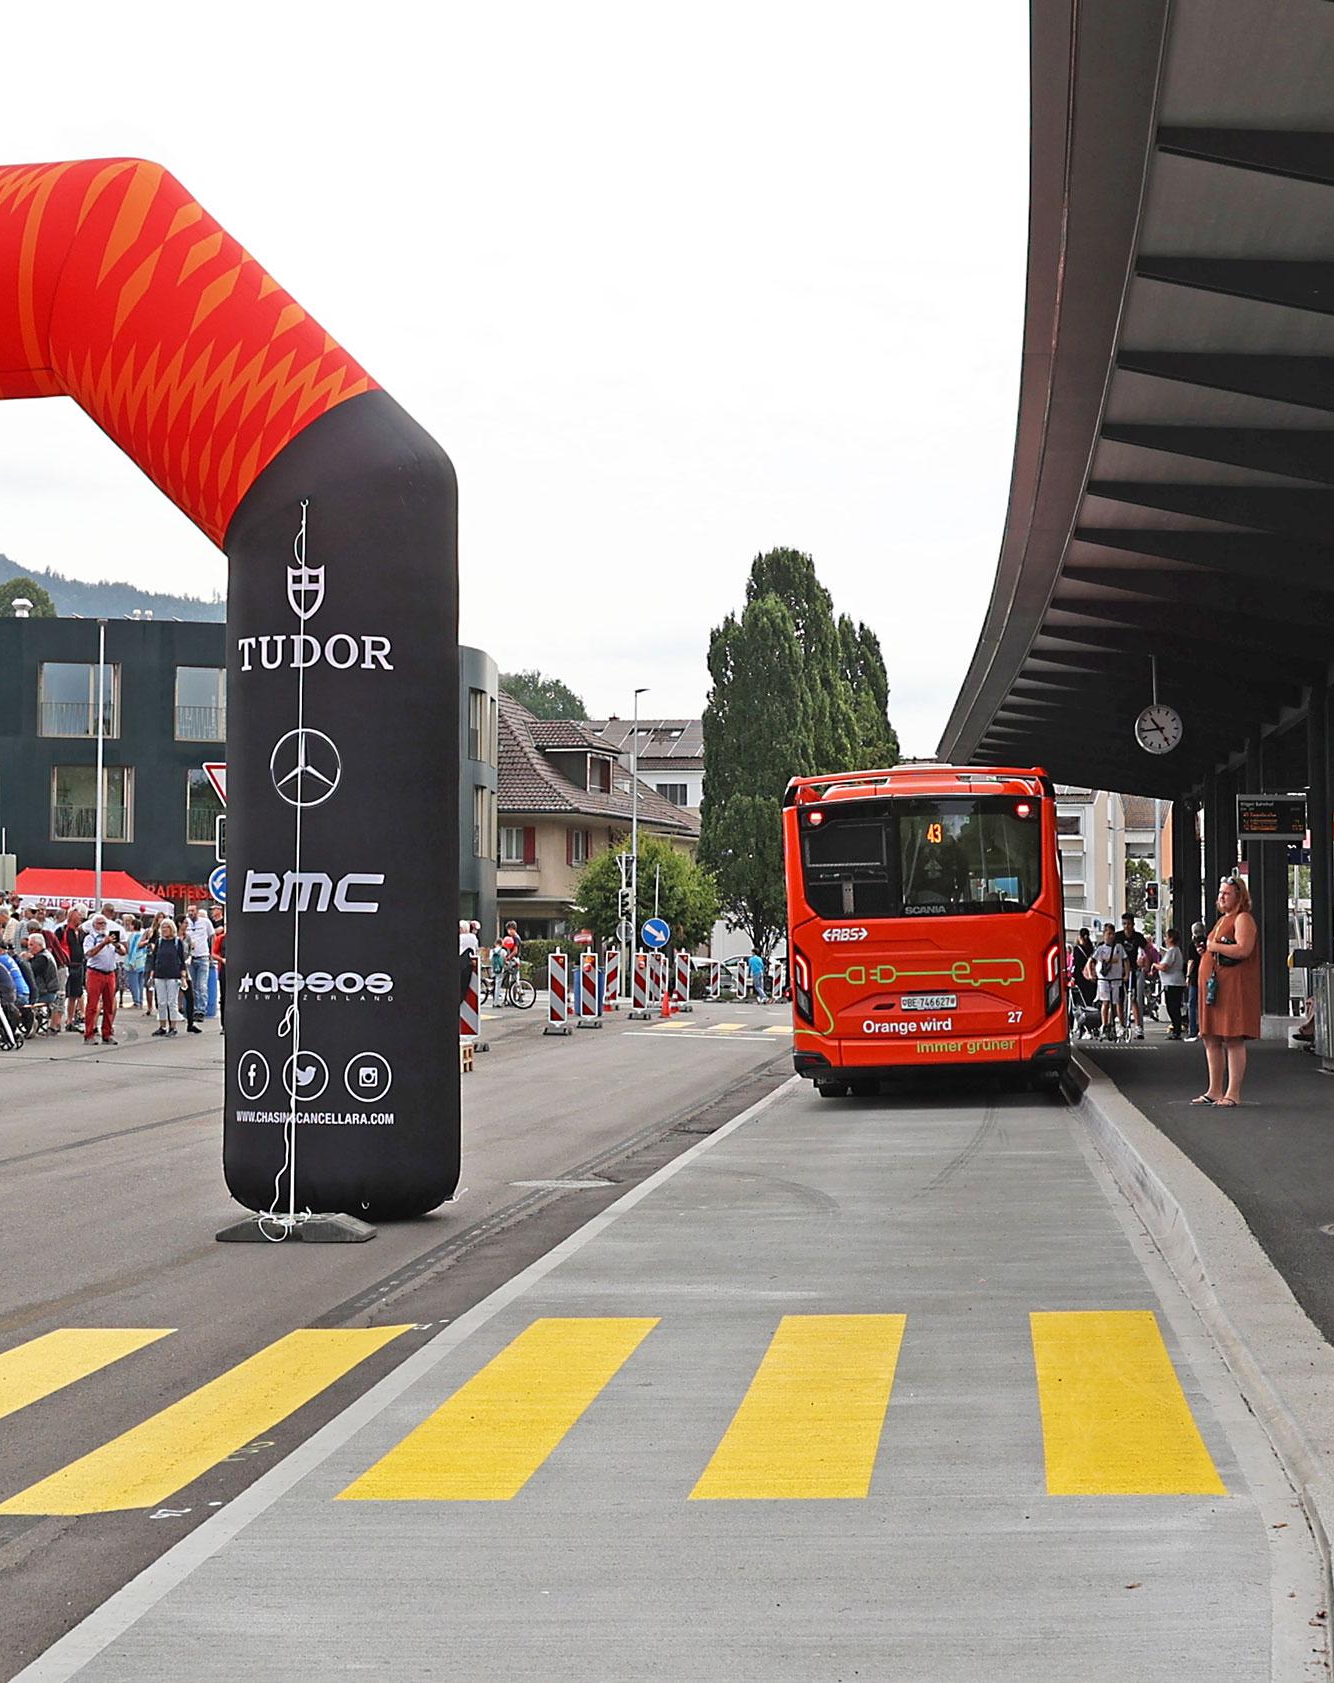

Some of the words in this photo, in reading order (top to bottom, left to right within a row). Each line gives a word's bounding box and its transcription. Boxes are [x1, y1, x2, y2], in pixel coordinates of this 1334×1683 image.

[238, 634, 394, 671] TUDOR
[927, 823, 942, 843] 43
[242, 870, 385, 912] BMC
[905, 906, 947, 915] SCANIA
[1007, 1011, 1023, 1023] 27
[862, 1020, 917, 1035] Orange
[920, 1018, 952, 1031] wird
[967, 1038, 1016, 1054] grüner
[236, 1111, 394, 1125] WWW.CHASINCANCELLARA.COM
